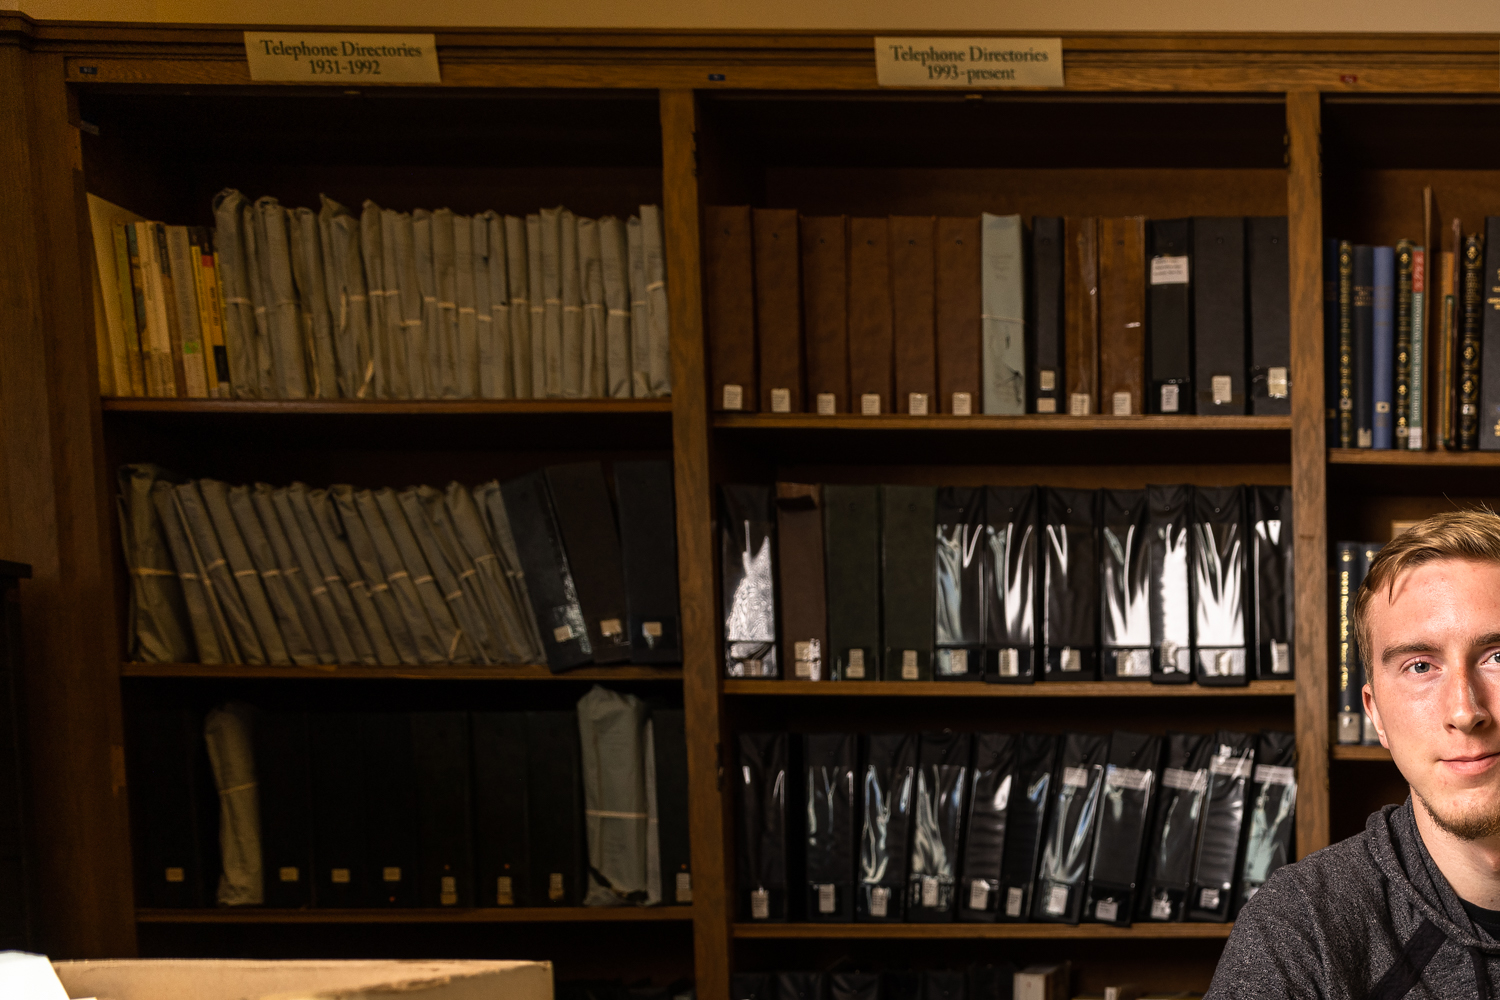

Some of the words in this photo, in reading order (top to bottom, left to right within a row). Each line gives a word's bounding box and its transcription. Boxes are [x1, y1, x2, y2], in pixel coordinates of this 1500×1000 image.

[259, 40, 338, 61] Telephone
[340, 41, 423, 58] Directories
[889, 45, 966, 67] Telephone
[968, 45, 1049, 62] Directories
[309, 60, 381, 75] 1931-1992
[927, 64, 1015, 84] 1993-present
